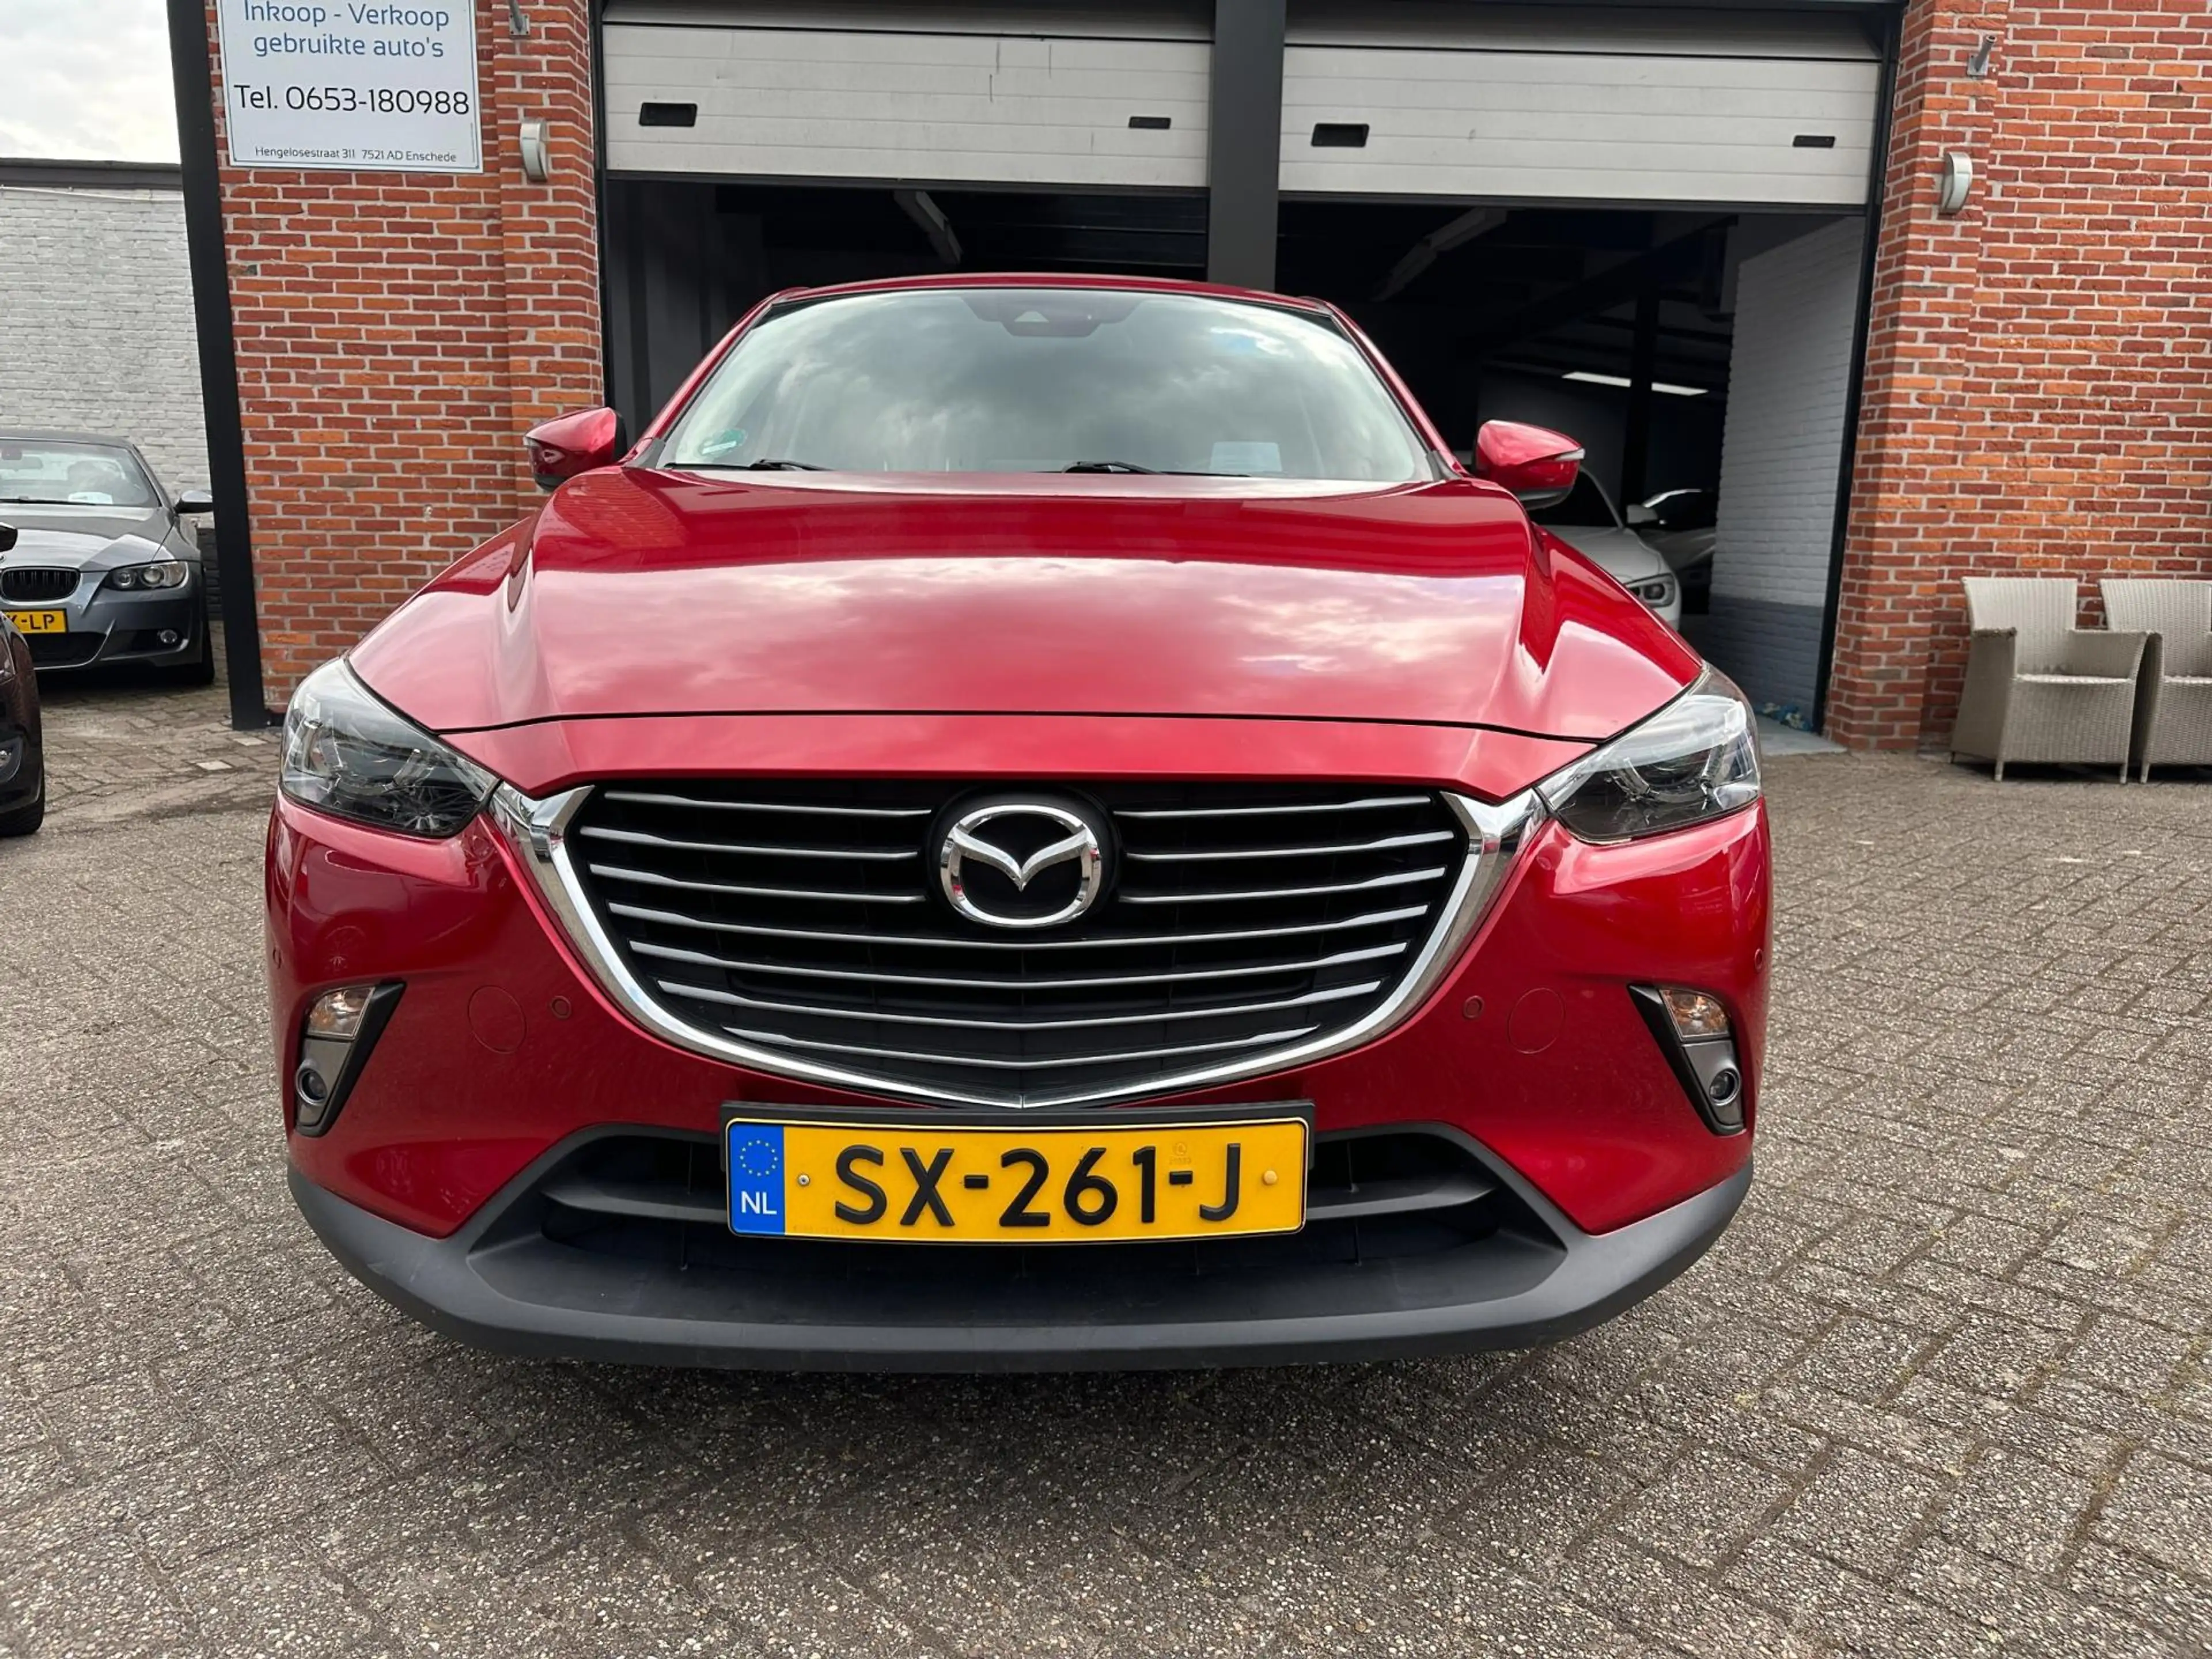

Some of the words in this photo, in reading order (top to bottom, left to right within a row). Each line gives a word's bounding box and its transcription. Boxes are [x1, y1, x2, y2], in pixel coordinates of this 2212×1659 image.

[244, 0, 326, 27] Inkoop
[348, 3, 449, 32] Verkoop
[254, 32, 365, 57] gebruikte
[374, 36, 444, 57] auto's
[234, 85, 278, 109] Tel.
[286, 86, 469, 115] 0653-180988
[255, 147, 340, 158] Hengelosestraat
[342, 149, 355, 158] 311
[362, 150, 384, 160] 7521
[387, 150, 403, 160] AD
[406, 151, 457, 162] Enschede
[834, 1143, 1241, 1228] SX-261-J
[741, 1191, 777, 1215] NL
